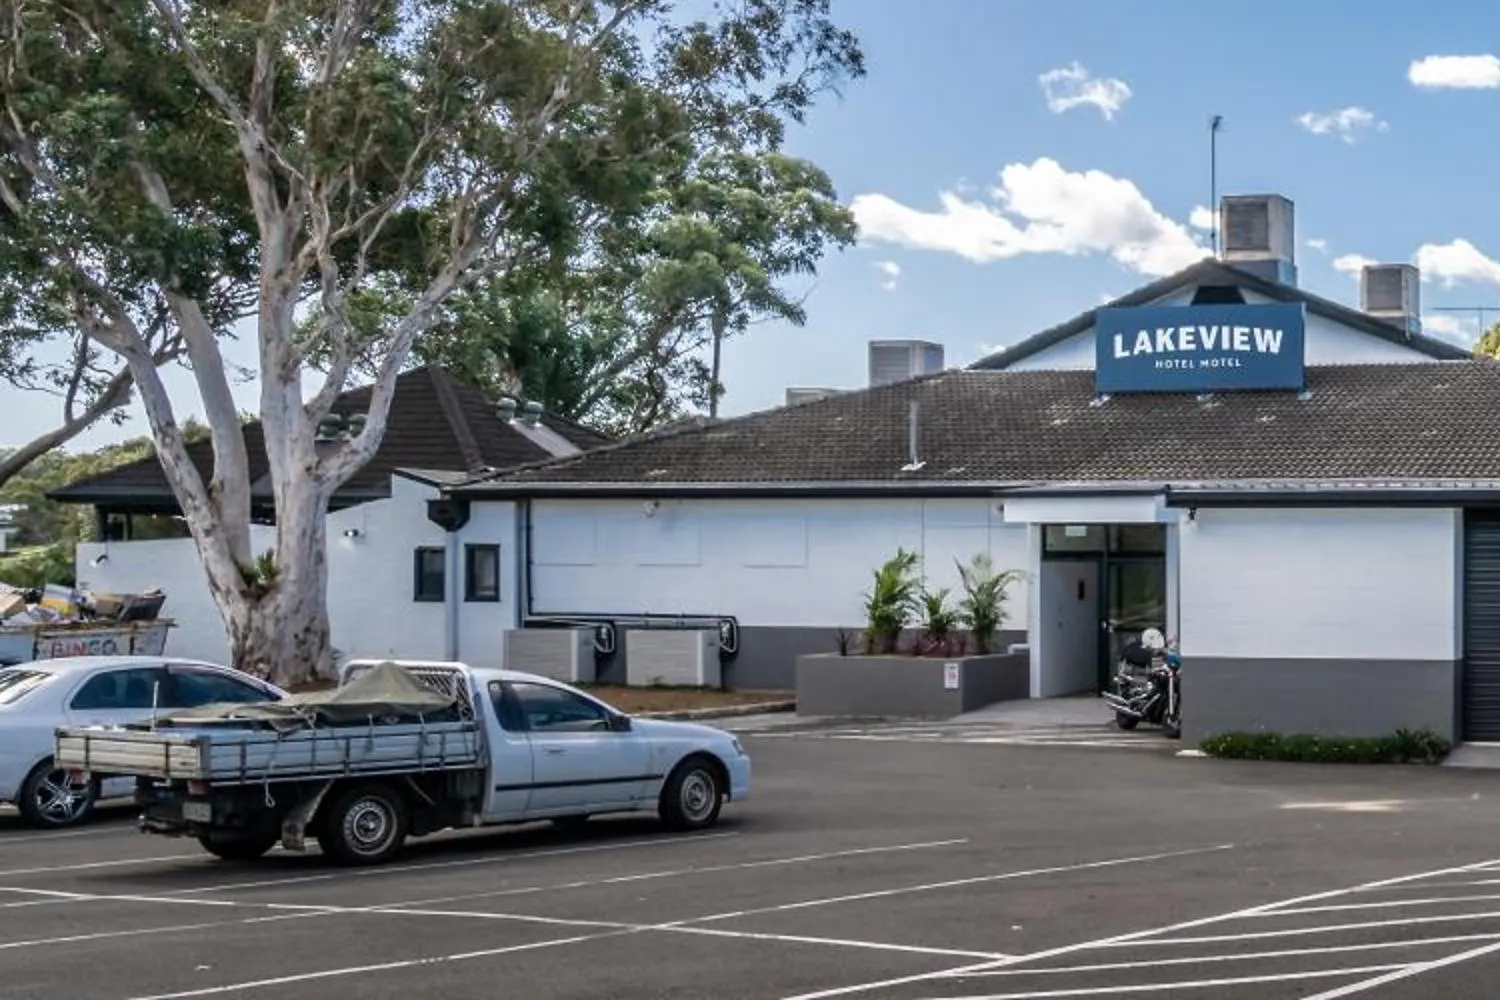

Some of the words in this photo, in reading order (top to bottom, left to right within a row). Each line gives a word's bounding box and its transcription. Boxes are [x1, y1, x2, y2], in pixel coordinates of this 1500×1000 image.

[1113, 325, 1283, 359] LAKEVIEW
[1155, 359, 1195, 369] HOTEL
[1200, 357, 1242, 368] MOTEL
